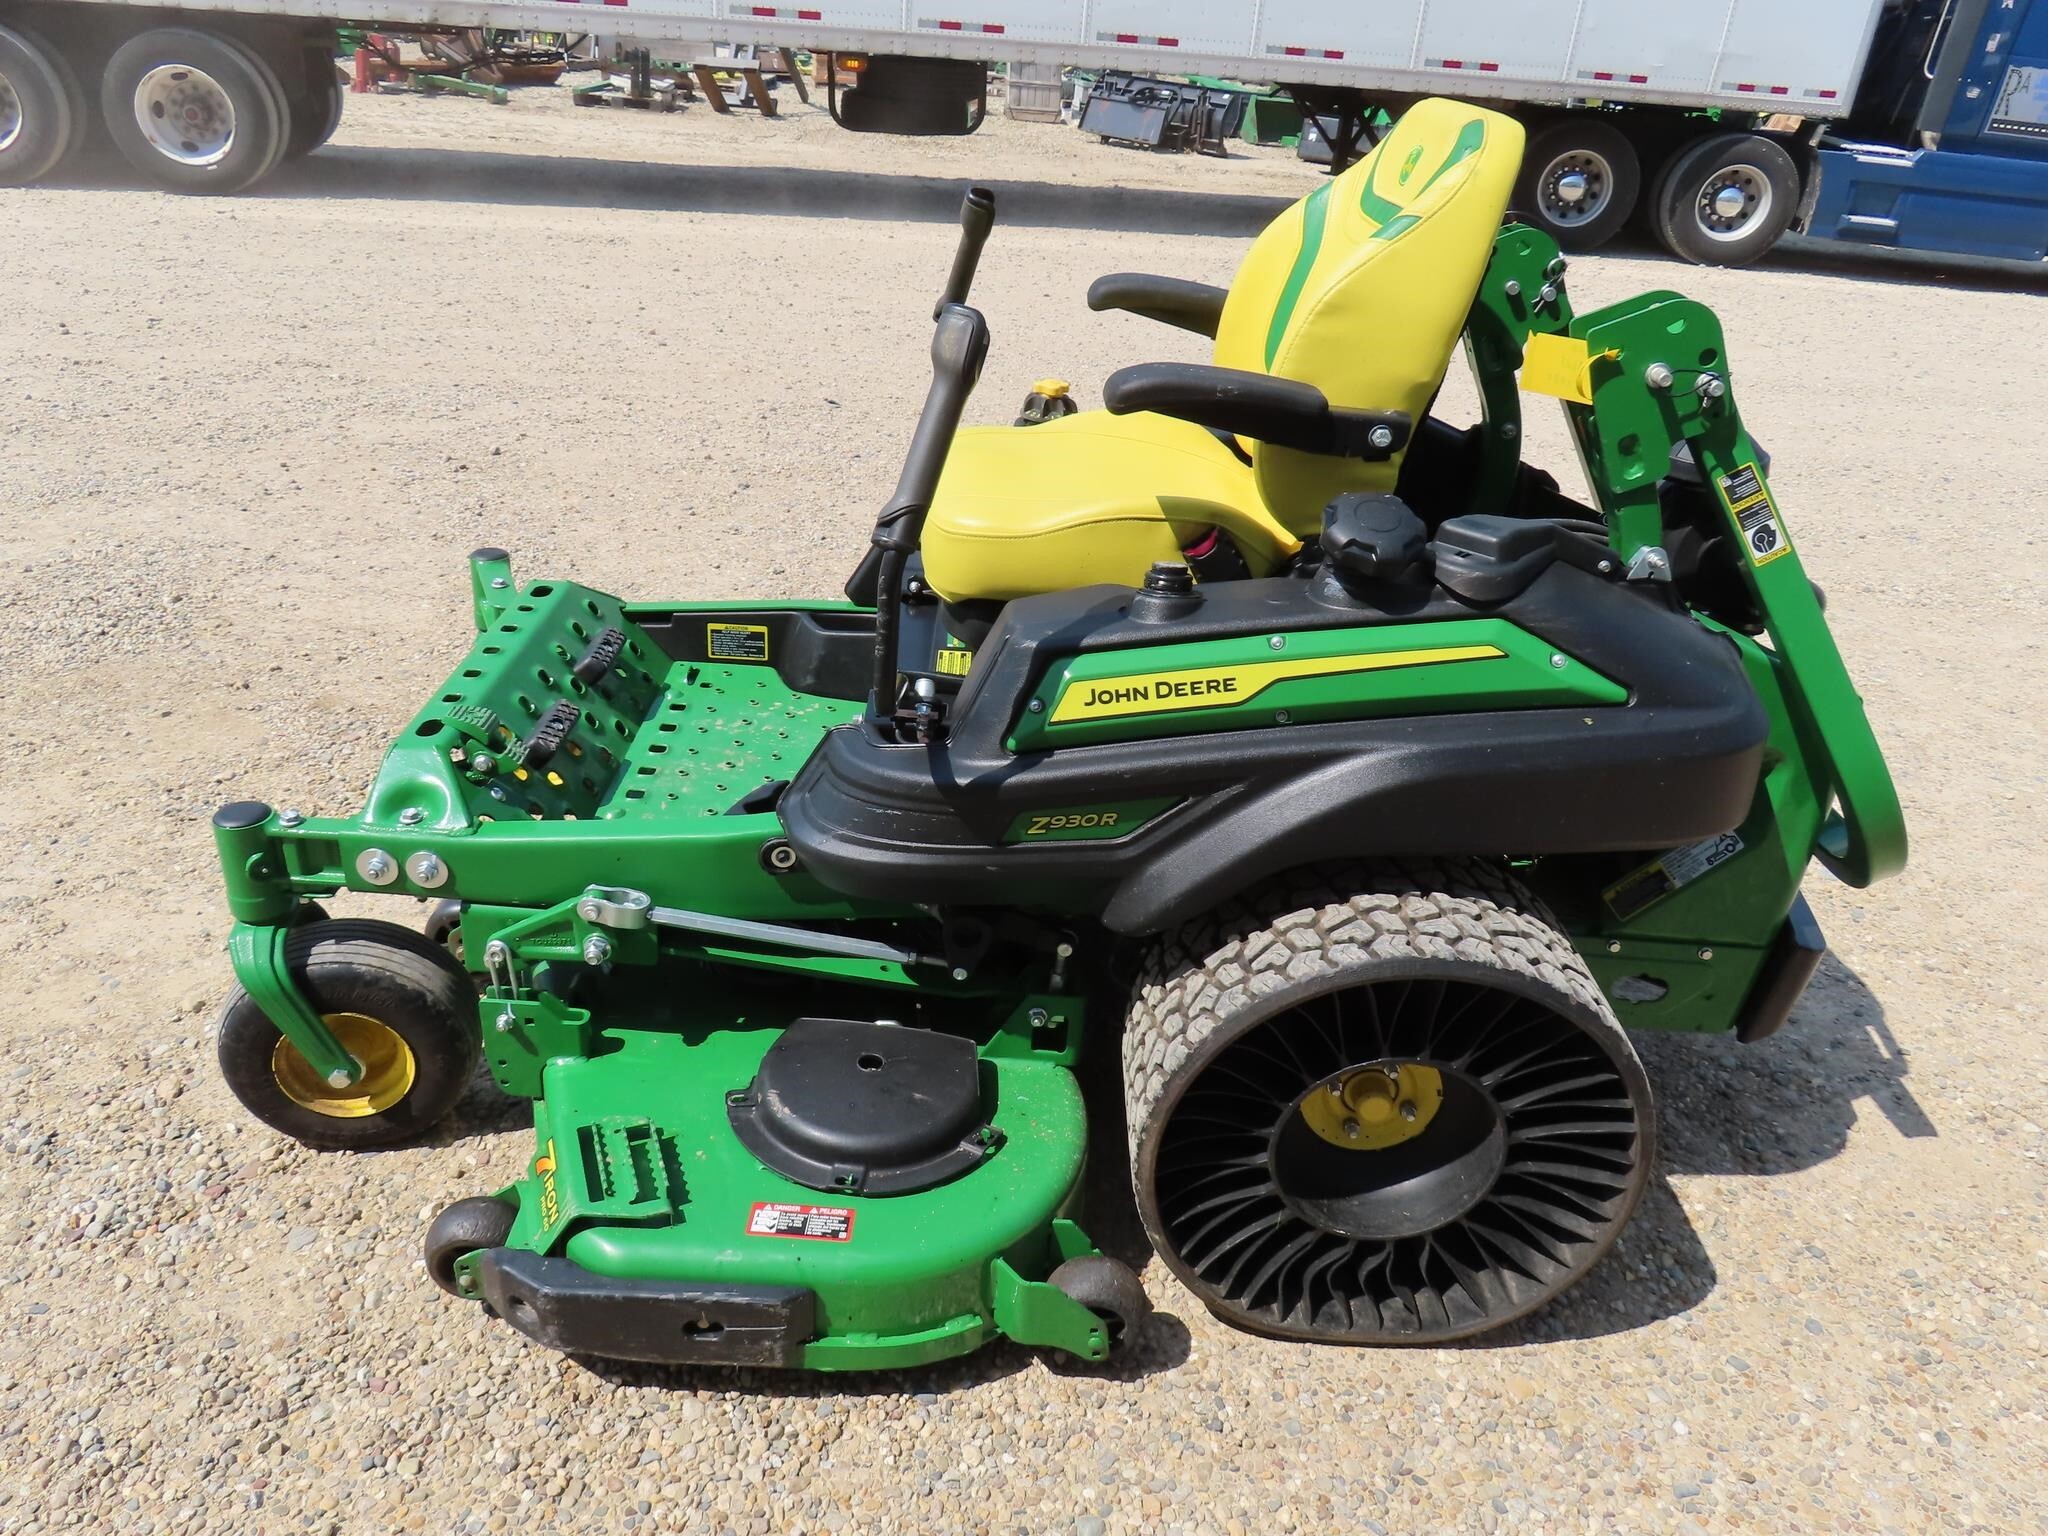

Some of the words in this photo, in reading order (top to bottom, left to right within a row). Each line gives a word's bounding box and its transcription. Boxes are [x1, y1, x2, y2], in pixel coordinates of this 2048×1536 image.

[1084, 686, 1149, 707] JOHN
[1155, 677, 1237, 699] DEERE
[819, 1208, 848, 1216] PELIGRO
